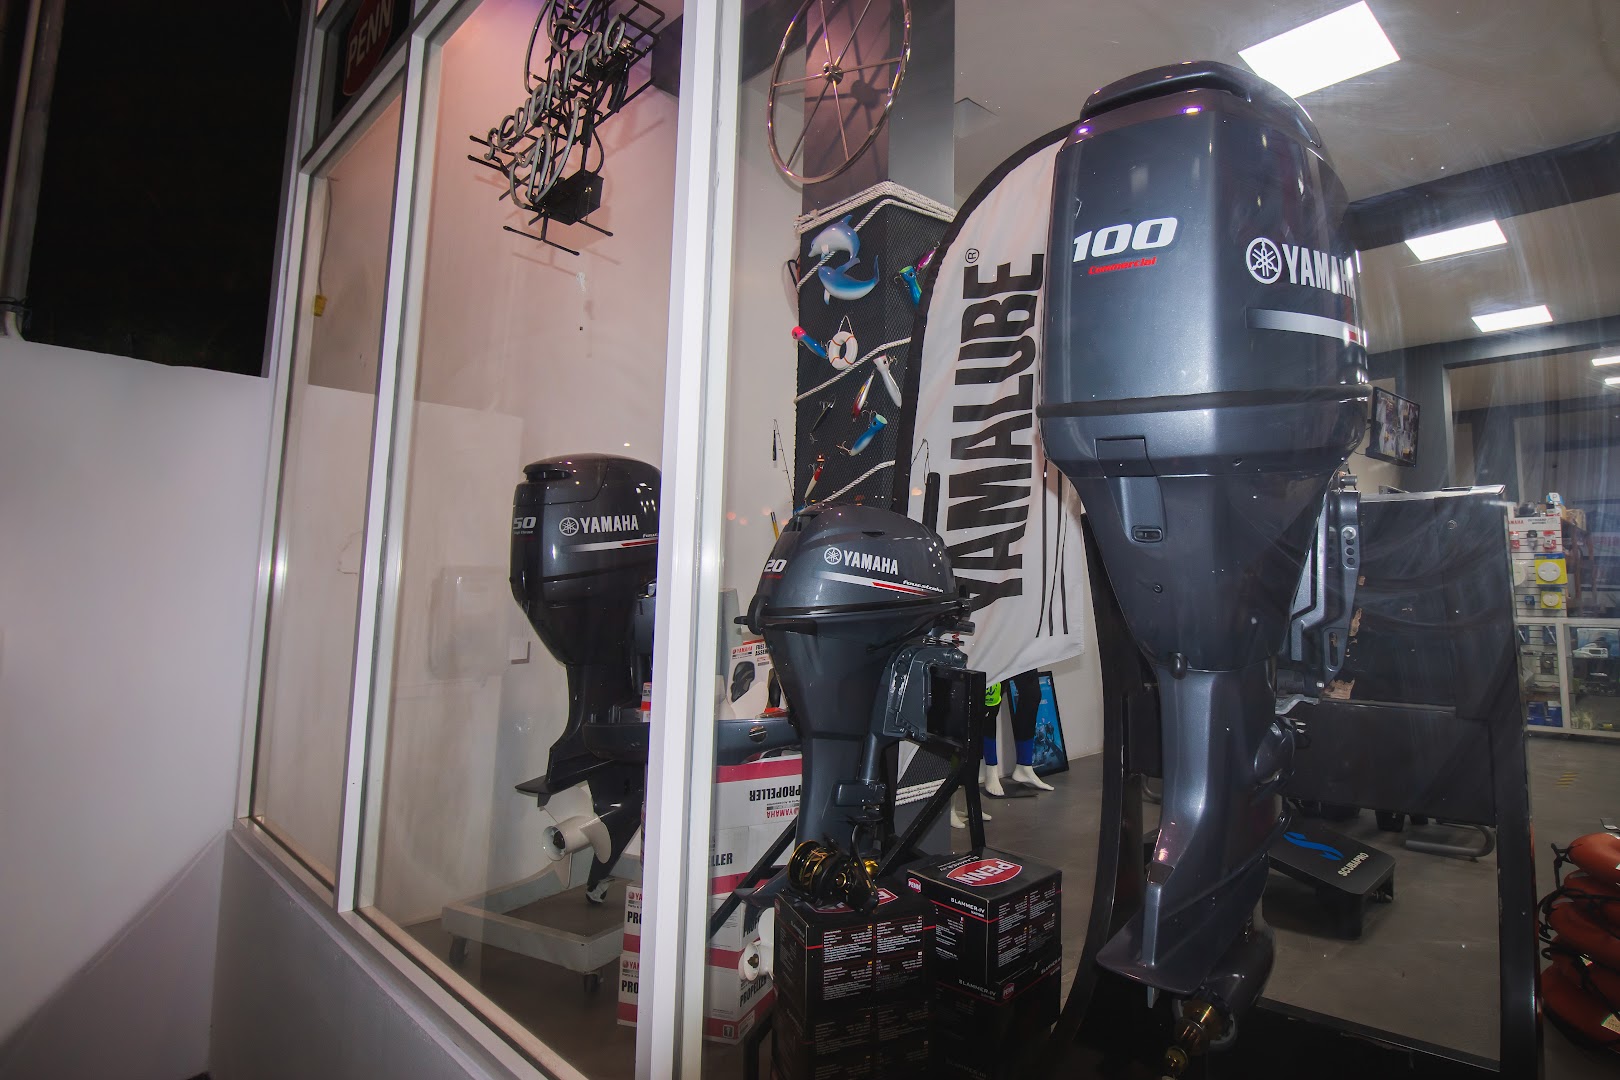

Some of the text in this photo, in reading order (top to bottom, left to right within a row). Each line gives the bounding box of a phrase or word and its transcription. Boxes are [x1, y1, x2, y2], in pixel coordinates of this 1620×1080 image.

[347, 0, 393, 78] PENN
[1073, 217, 1178, 262] 100
[1088, 256, 1157, 275] Commercial
[947, 253, 1045, 612] YAMALUBE
[580, 514, 640, 534] YAMAHA
[764, 559, 788, 573] 20
[843, 550, 899, 576] YAMAHA
[749, 784, 801, 802] PROPELLER
[766, 808, 793, 819] YAMAHA
[954, 860, 1015, 884] PENN
